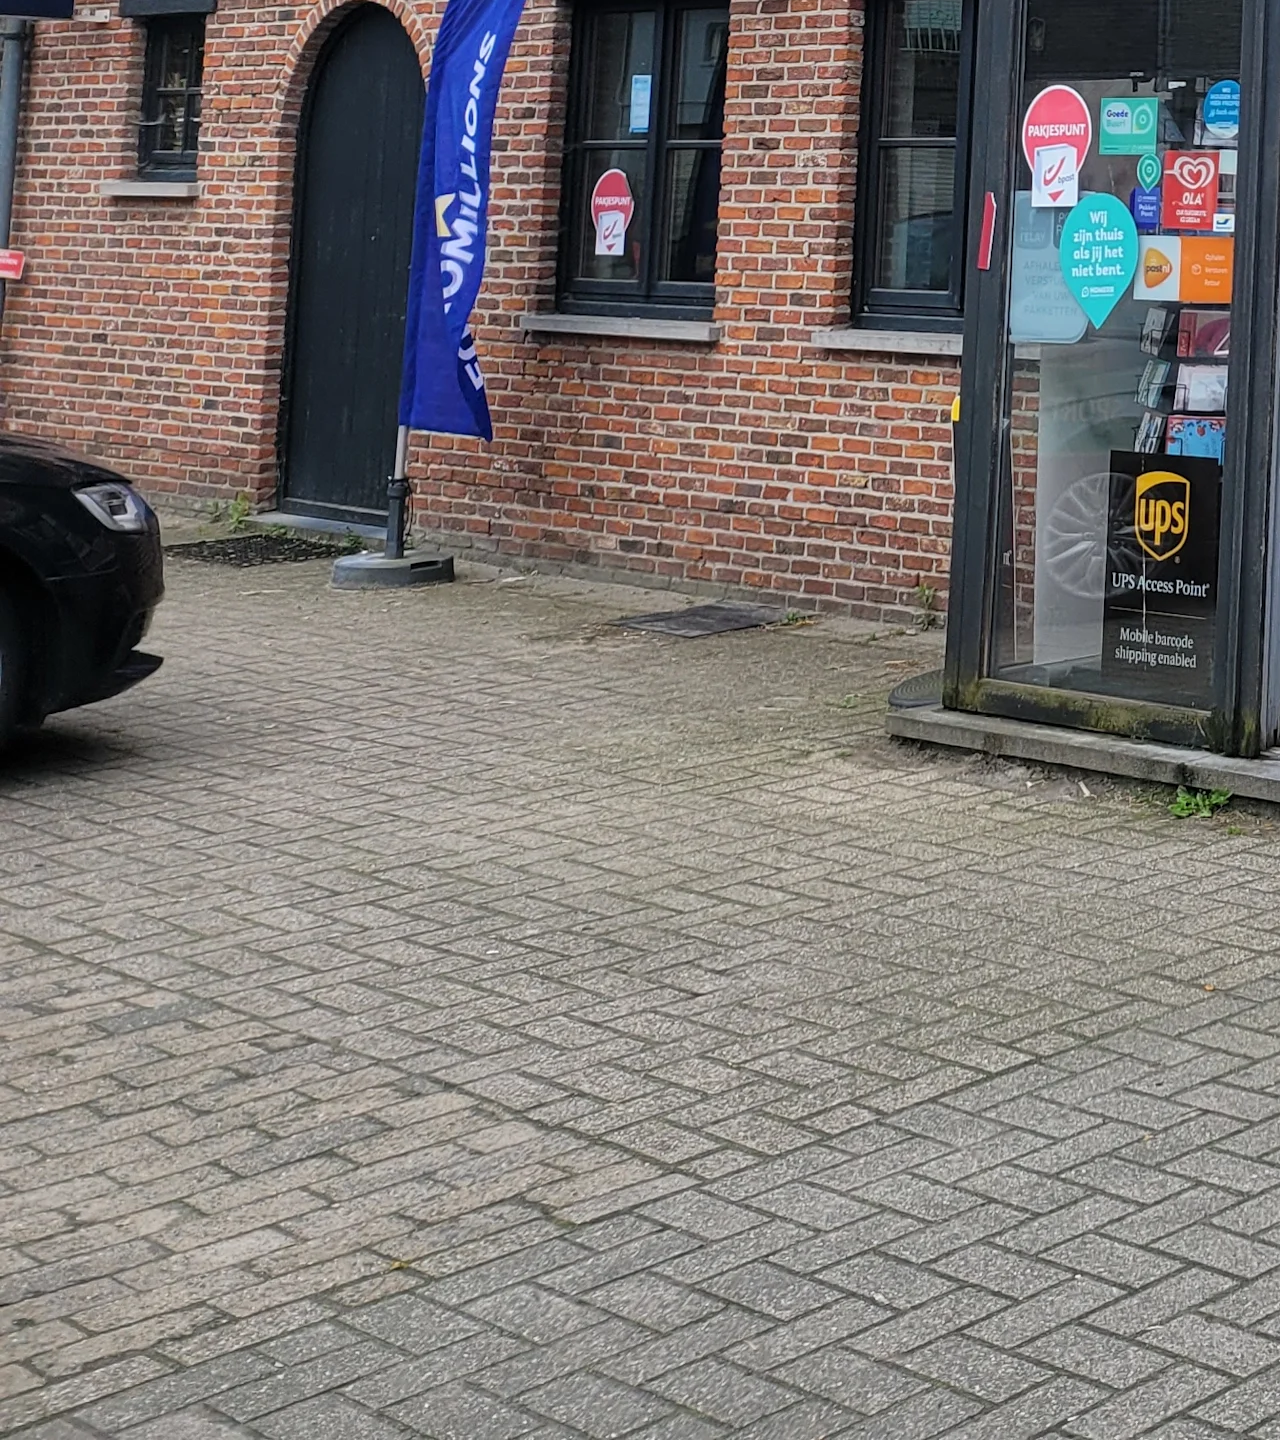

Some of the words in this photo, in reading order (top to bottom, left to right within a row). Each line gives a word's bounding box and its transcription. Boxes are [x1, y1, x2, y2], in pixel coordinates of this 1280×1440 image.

[1106, 109, 1129, 118] Goede
[1028, 124, 1086, 137] PAKJESPUNT
[1090, 211, 1108, 228] Wij
[1073, 229, 1093, 242] zijn
[1095, 227, 1124, 240] thuis
[1073, 248, 1090, 260] als
[1091, 247, 1103, 262] jij
[1105, 246, 1124, 258] het
[1071, 263, 1094, 277] niet
[1096, 262, 1125, 276] bent.
[1139, 498, 1185, 546] ups
[1112, 572, 1135, 590] UPS
[1137, 575, 1174, 594] Access
[1176, 579, 1207, 598] Point
[1120, 627, 1154, 645] Mobile
[1155, 631, 1194, 649] barcode
[1115, 645, 1156, 667] shipping
[1157, 651, 1197, 668] enabled
